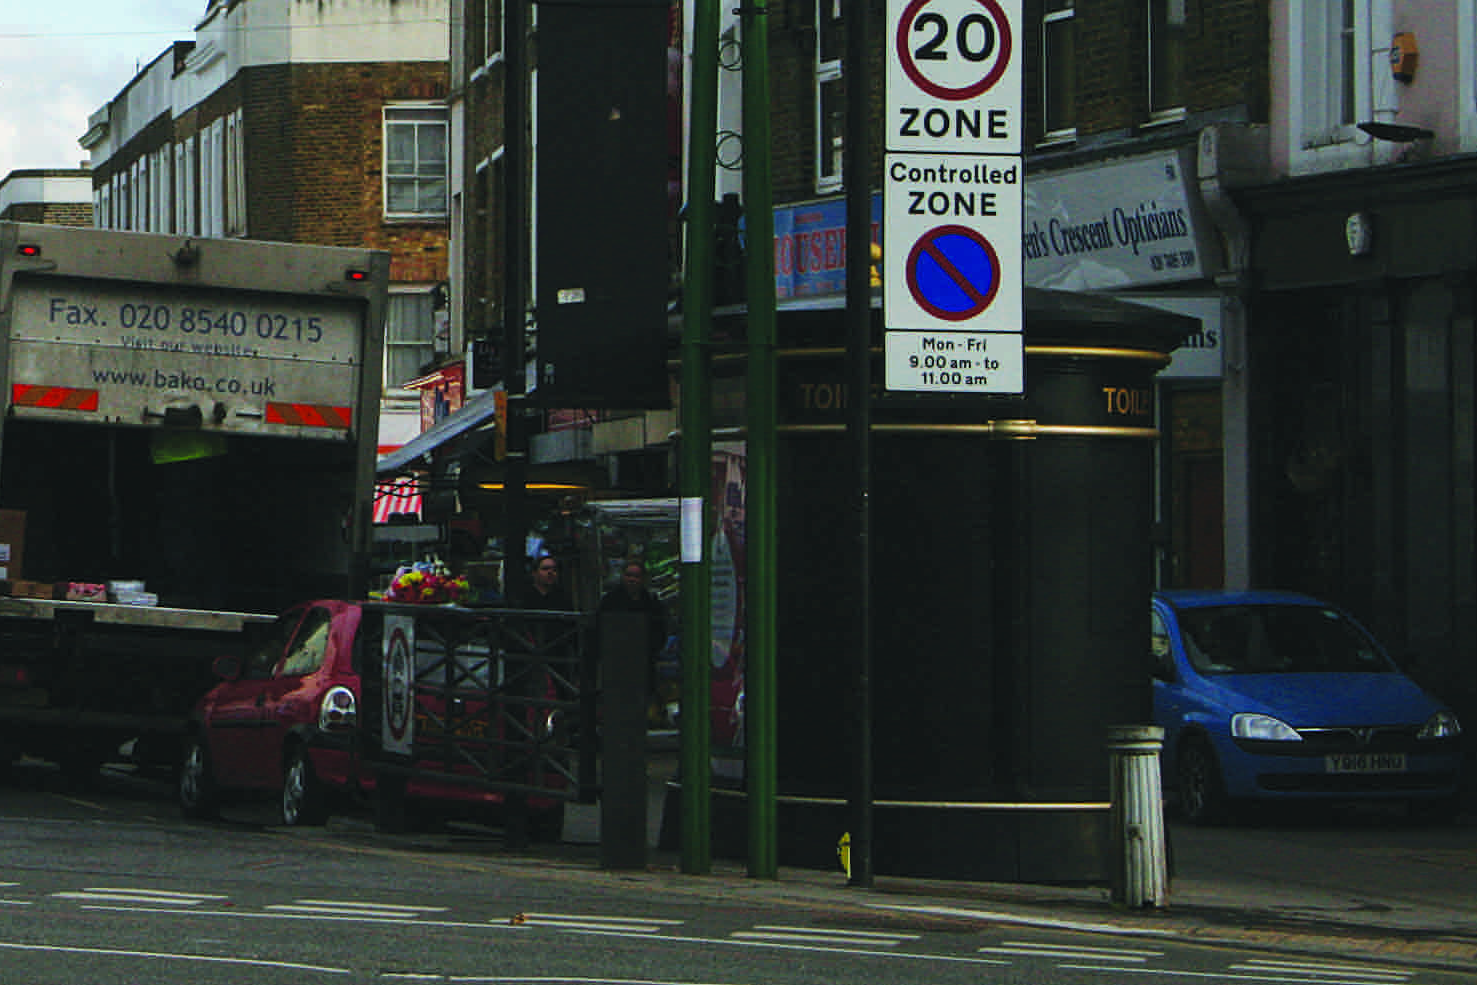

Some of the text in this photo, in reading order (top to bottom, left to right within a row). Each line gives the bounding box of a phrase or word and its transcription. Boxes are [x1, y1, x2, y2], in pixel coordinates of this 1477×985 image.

[912, 13, 996, 62] 20
[899, 108, 1009, 139] ZONE
[890, 162, 1018, 187] Controlled
[907, 192, 998, 216] ZONE
[1049, 216, 1114, 258] Crescent
[1112, 200, 1188, 256] Opticians
[48, 297, 323, 343] Fax. 020 8540 0215
[922, 337, 954, 351] Mon
[967, 337, 987, 351] Fri
[909, 355, 947, 369] 9.00
[950, 359, 972, 369] am
[984, 357, 999, 370] to
[91, 368, 277, 397] www.bako.co.uk
[921, 371, 987, 385] 11.00 am
